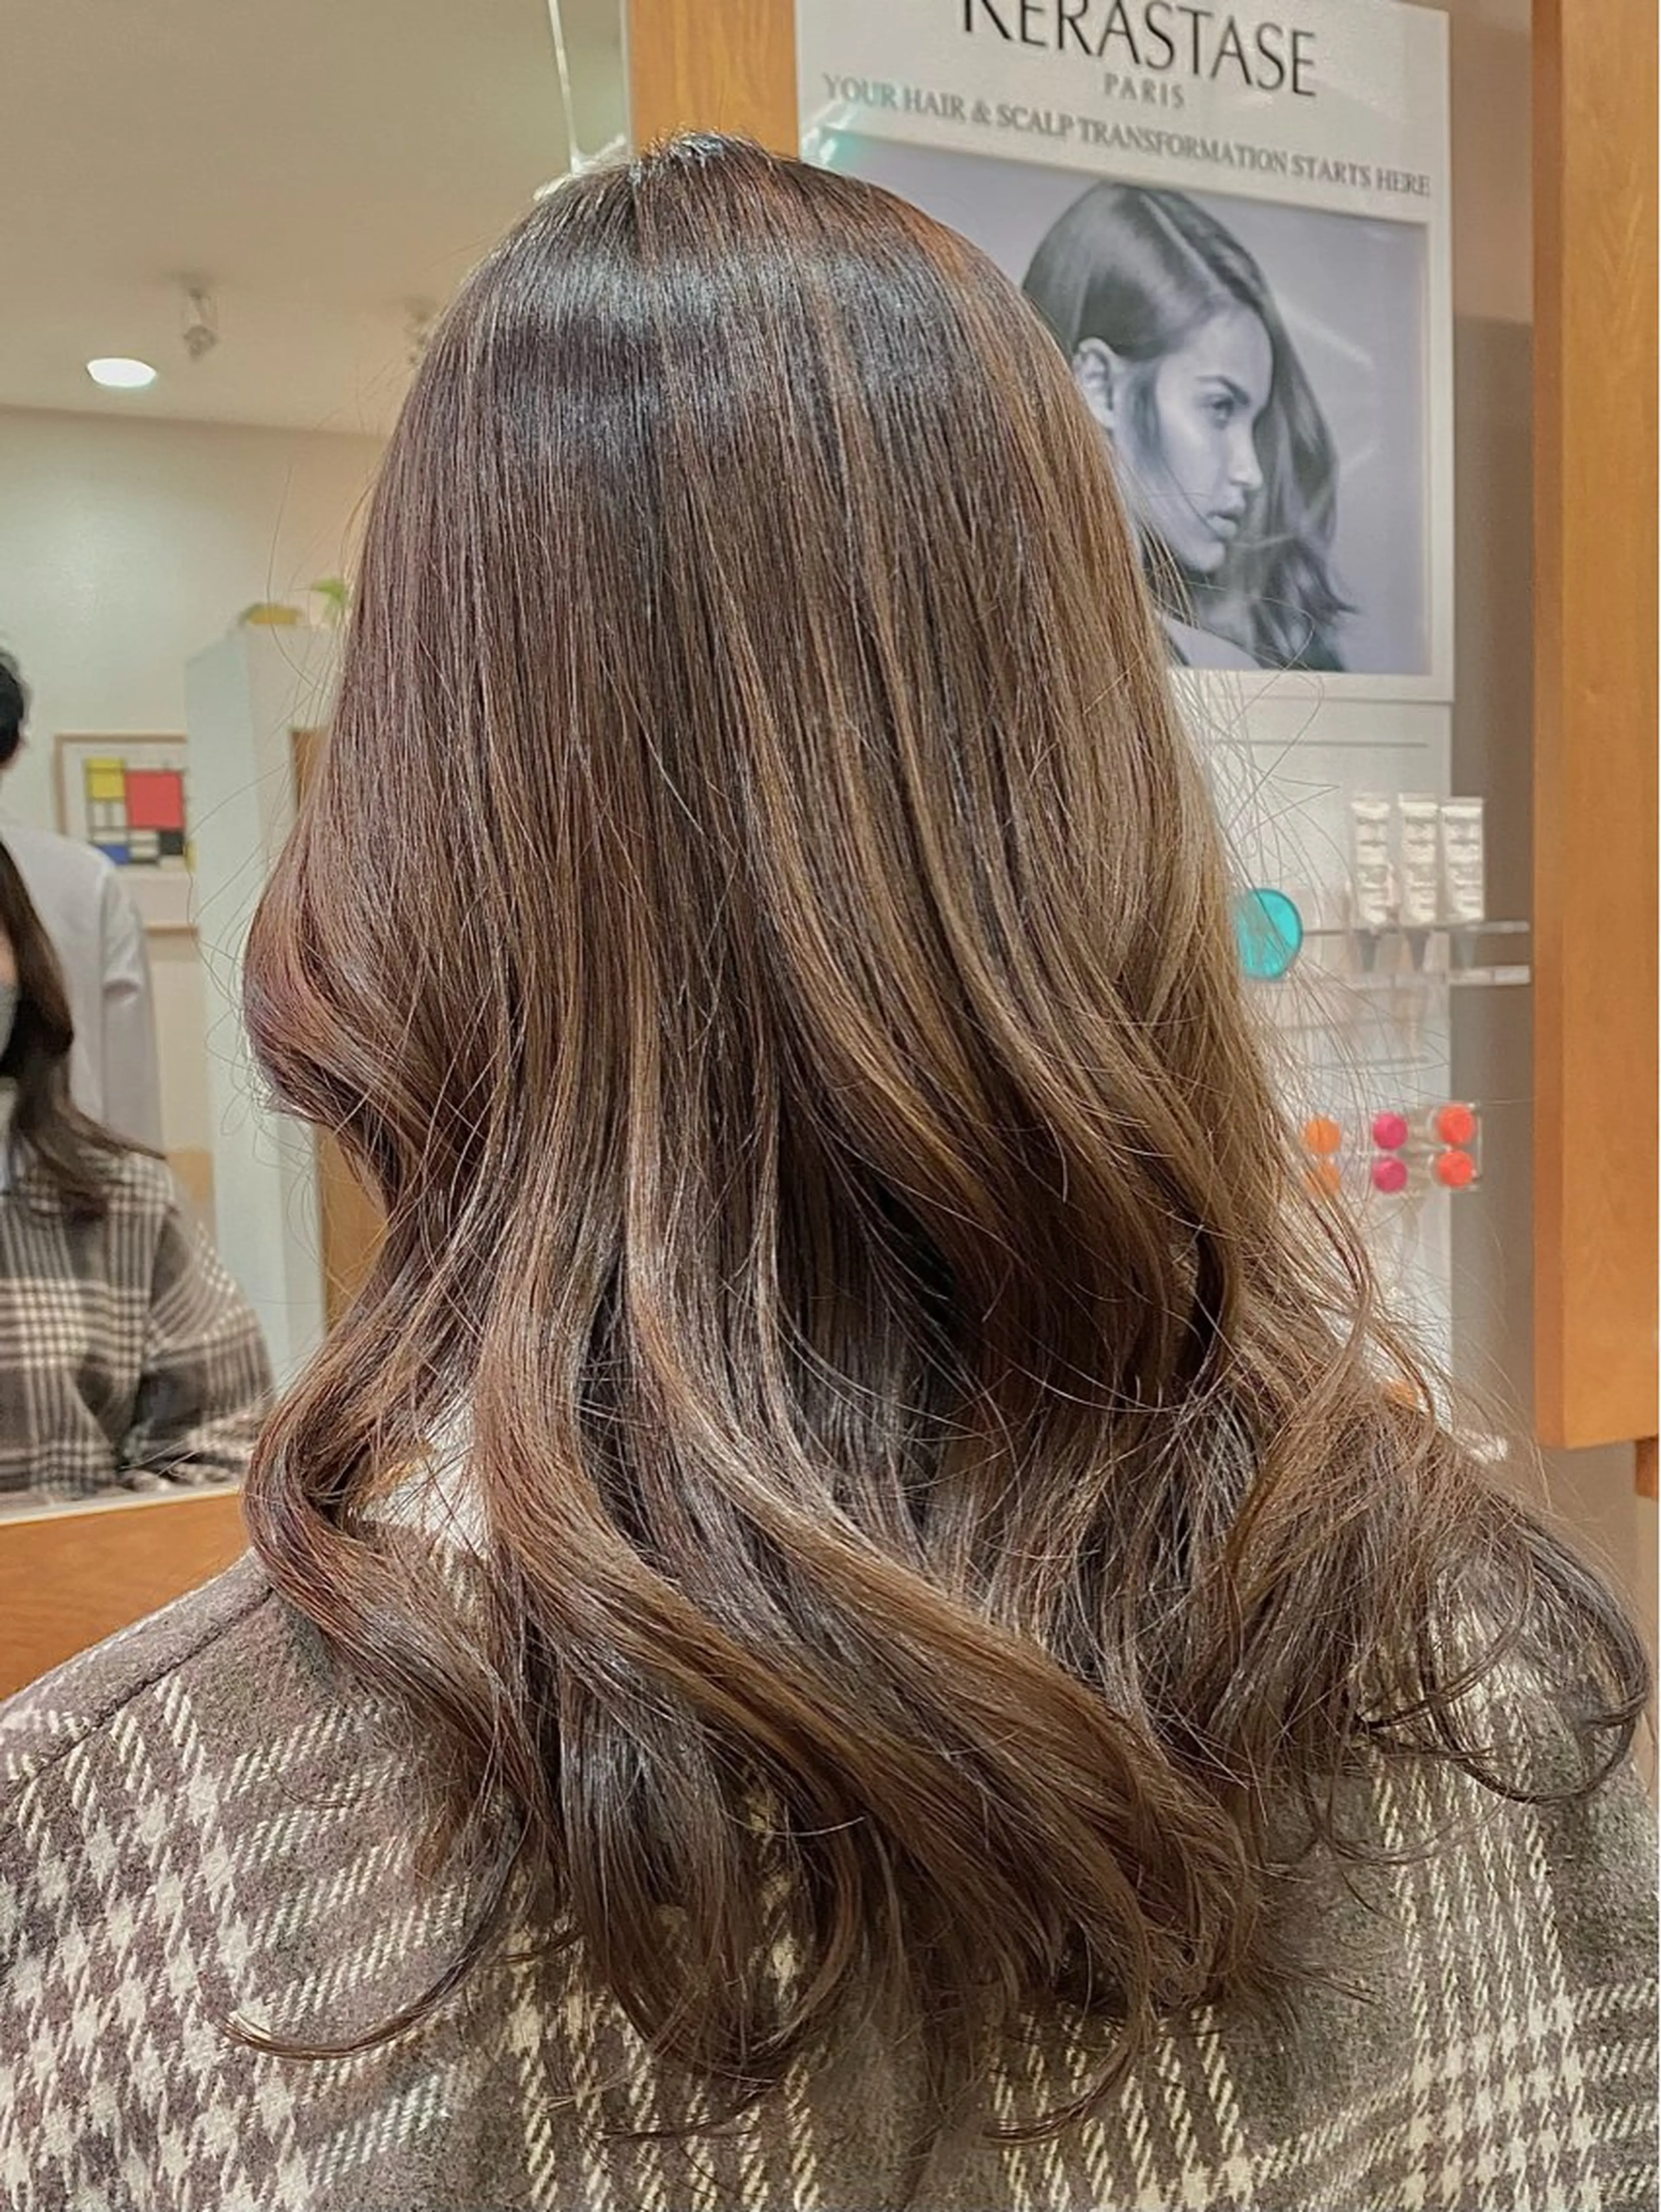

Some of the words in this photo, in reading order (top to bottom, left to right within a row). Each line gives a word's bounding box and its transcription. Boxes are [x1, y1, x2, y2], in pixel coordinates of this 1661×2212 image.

[1104, 72, 1185, 109] PARIS
[822, 73, 897, 109] YOUR
[904, 87, 965, 122] HAIR
[972, 100, 991, 125] &
[996, 104, 1074, 138] SCALP
[1078, 117, 1287, 173] TRANSFORMATION
[1291, 155, 1371, 187] STARTS
[1376, 167, 1430, 197] HERE
